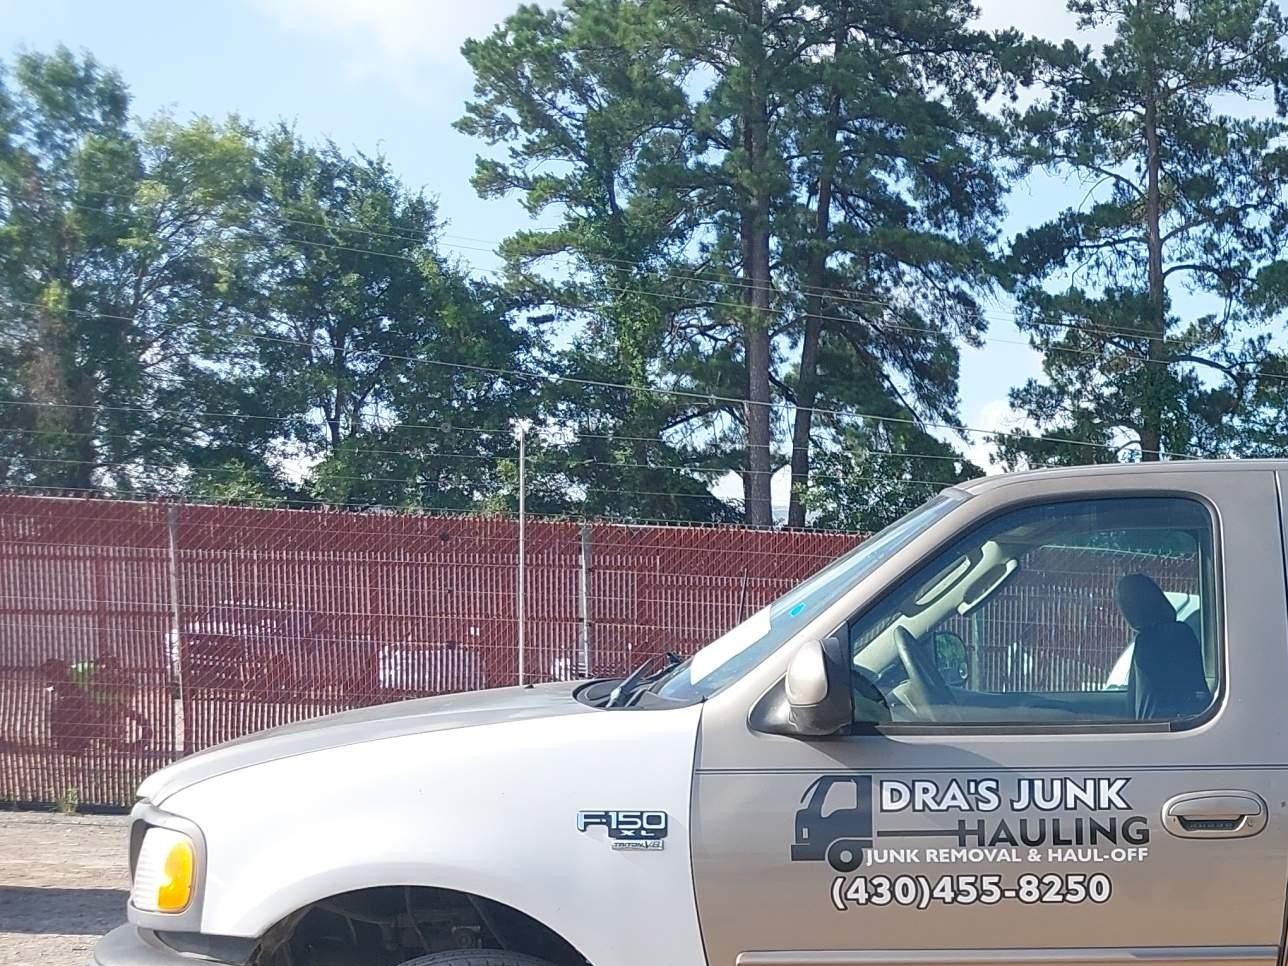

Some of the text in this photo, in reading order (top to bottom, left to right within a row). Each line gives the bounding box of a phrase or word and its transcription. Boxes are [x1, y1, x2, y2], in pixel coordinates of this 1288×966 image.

[879, 776, 1132, 812] DRA'S JUNK
[577, 810, 667, 832] F-150
[957, 815, 1151, 848] HAULING
[866, 847, 1150, 867] JUNK REMOVAL & HAUL-OFF
[831, 873, 1112, 911] (430)455-8250
